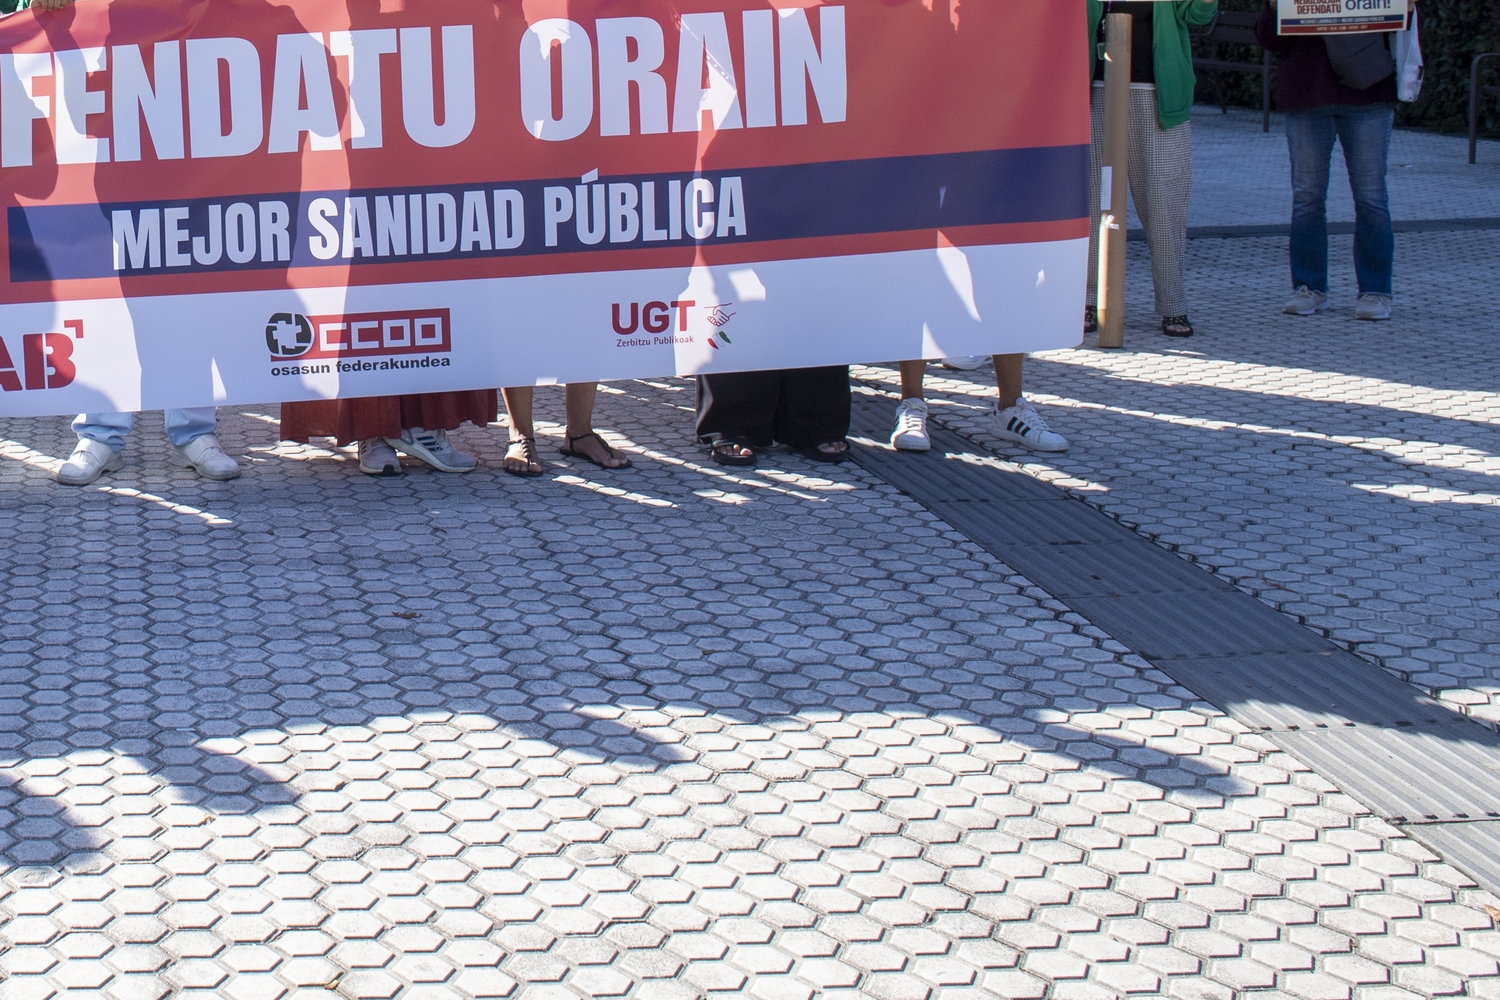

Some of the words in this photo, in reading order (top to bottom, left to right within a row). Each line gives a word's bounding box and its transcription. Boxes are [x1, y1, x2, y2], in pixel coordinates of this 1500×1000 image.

[1297, 4, 1341, 15] DEFENDATU
[517, 4, 848, 140] ORAIN
[111, 199, 290, 271] MEJOR
[308, 189, 524, 261] SANIDAD
[543, 167, 747, 247] PÚBLICA
[318, 317, 443, 352] CCOO
[611, 300, 696, 335] UGT
[616, 336, 651, 347] Zerbitzu
[653, 335, 695, 346] Publikoak
[270, 362, 331, 377] osasun
[335, 355, 451, 374] federakundea
